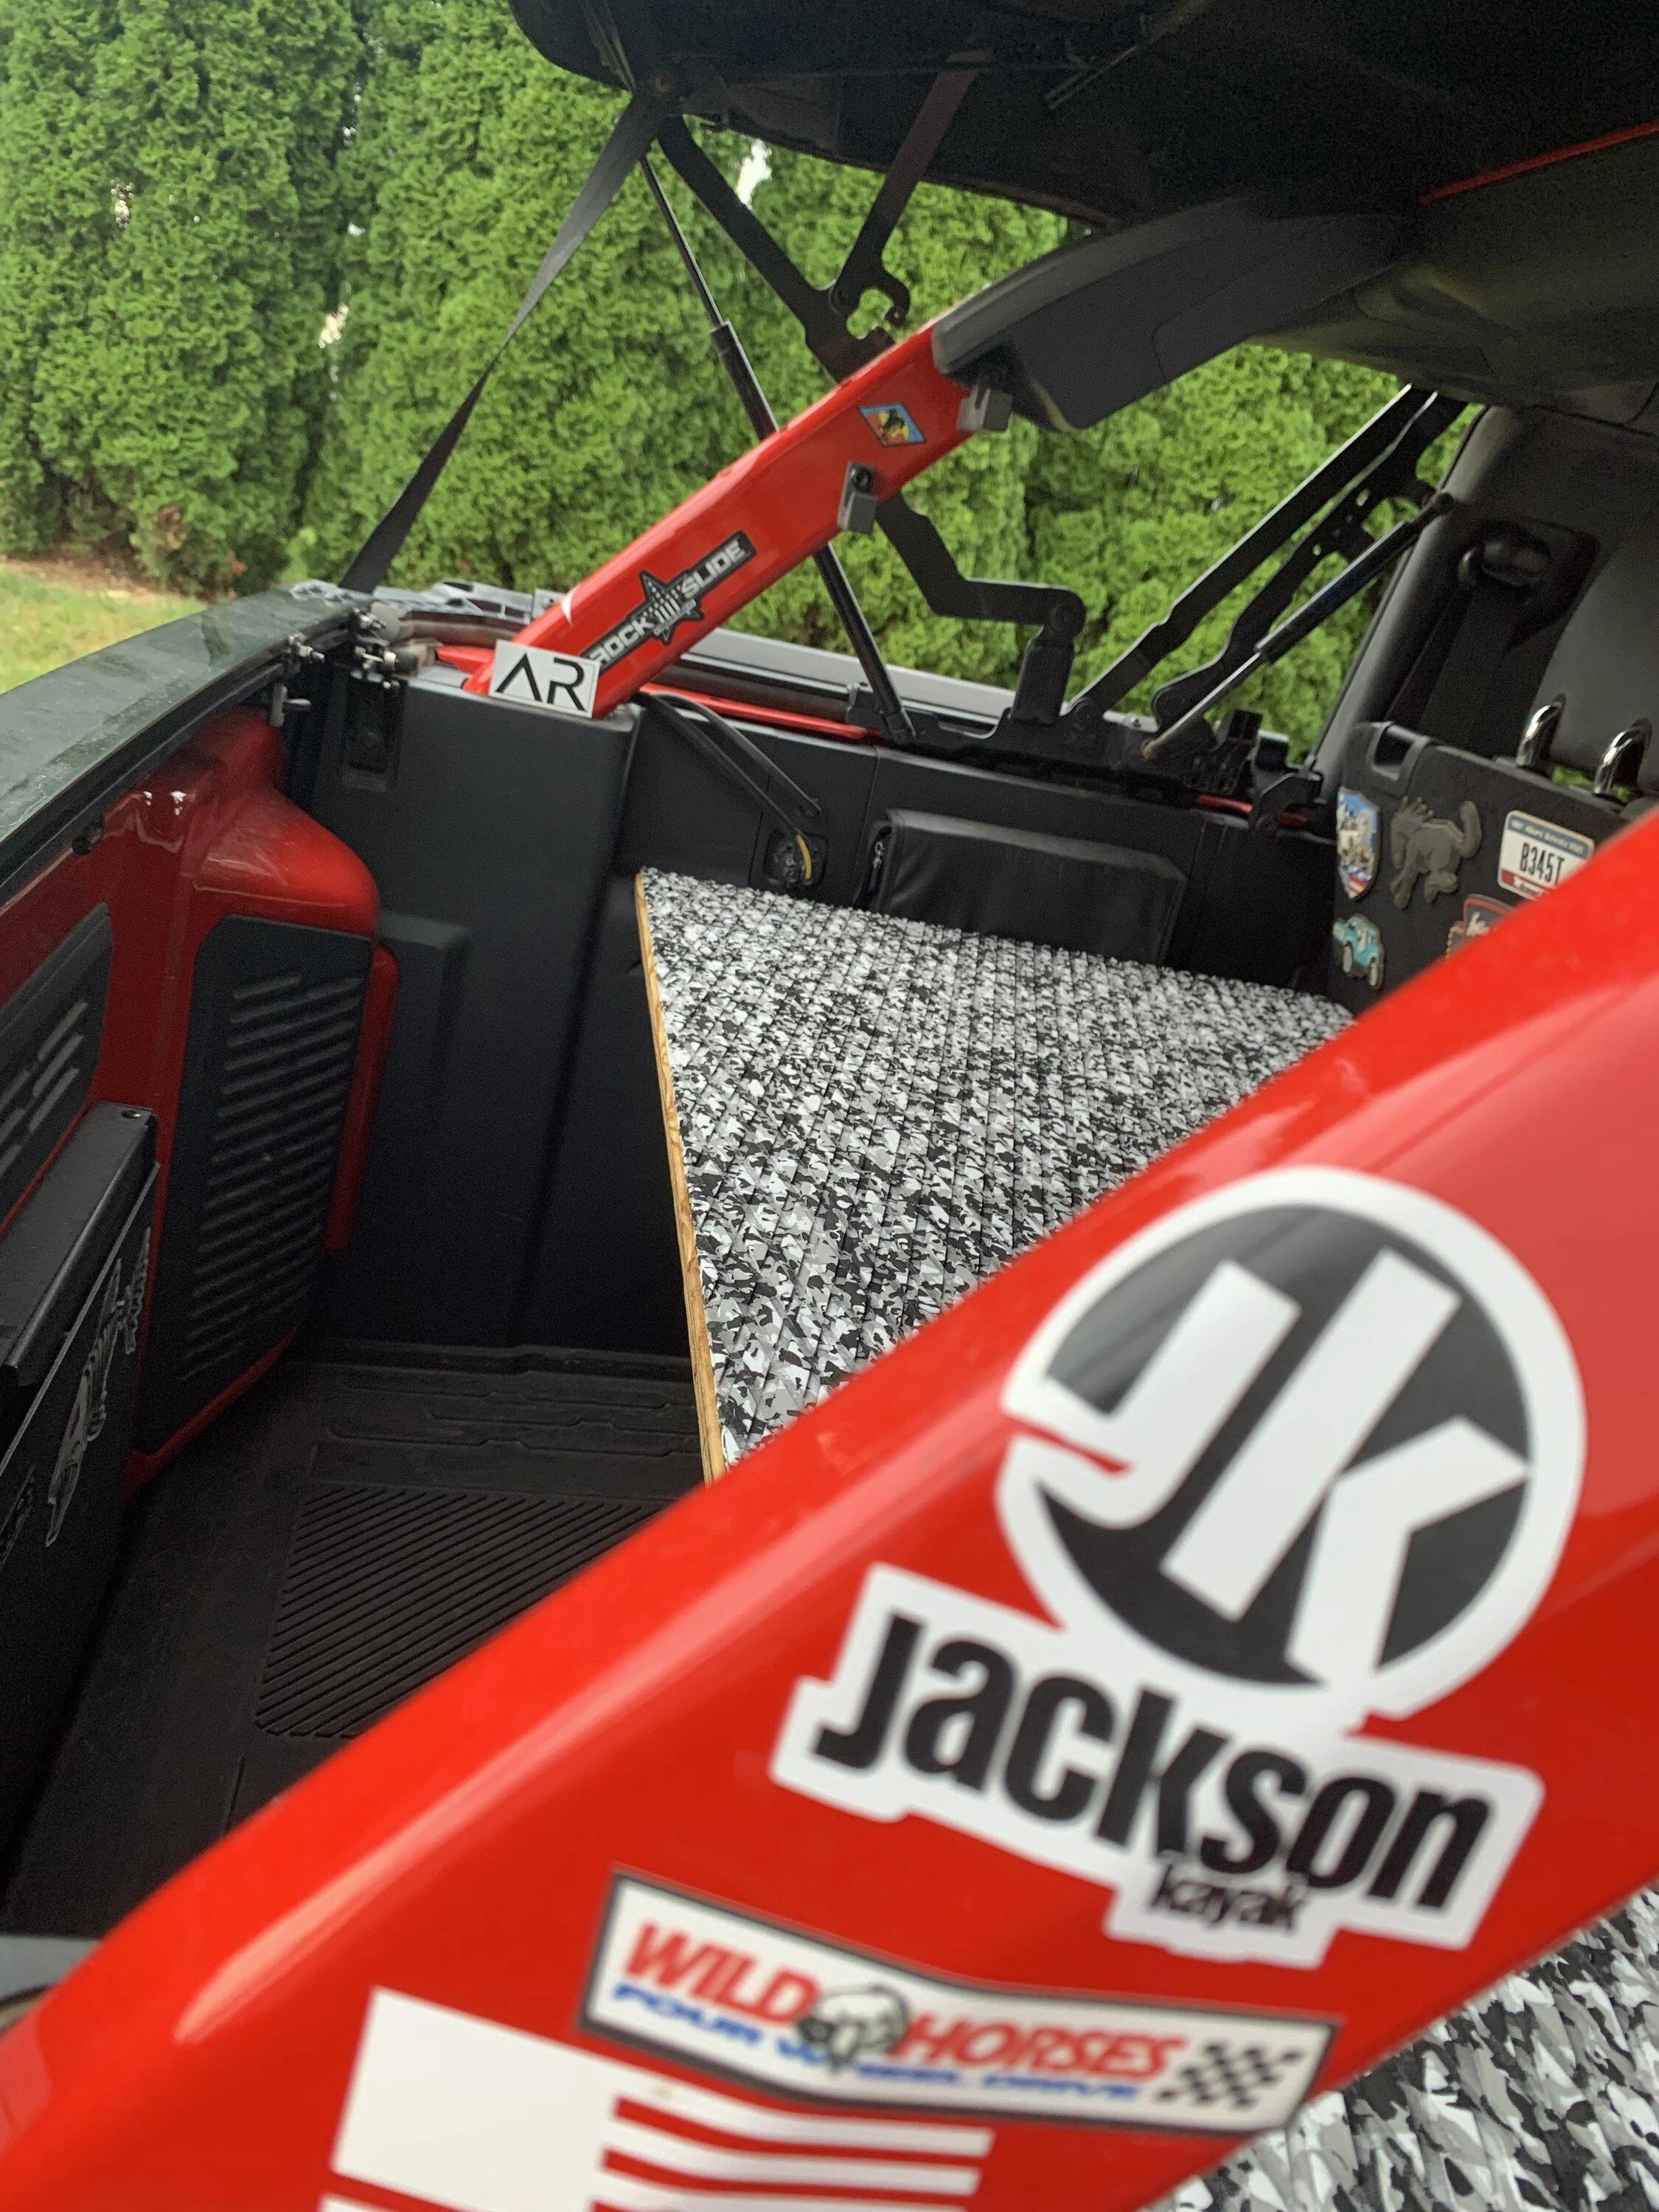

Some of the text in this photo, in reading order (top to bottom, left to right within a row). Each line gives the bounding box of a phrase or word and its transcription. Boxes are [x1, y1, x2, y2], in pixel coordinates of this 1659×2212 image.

[590, 616, 655, 664] ROCK
[681, 539, 746, 599] SLIDE
[495, 653, 587, 712] AR
[1006, 1246, 1534, 1696] JK
[1150, 1862, 1306, 1933] kayak
[623, 1920, 1189, 2081] WILD HORSES
